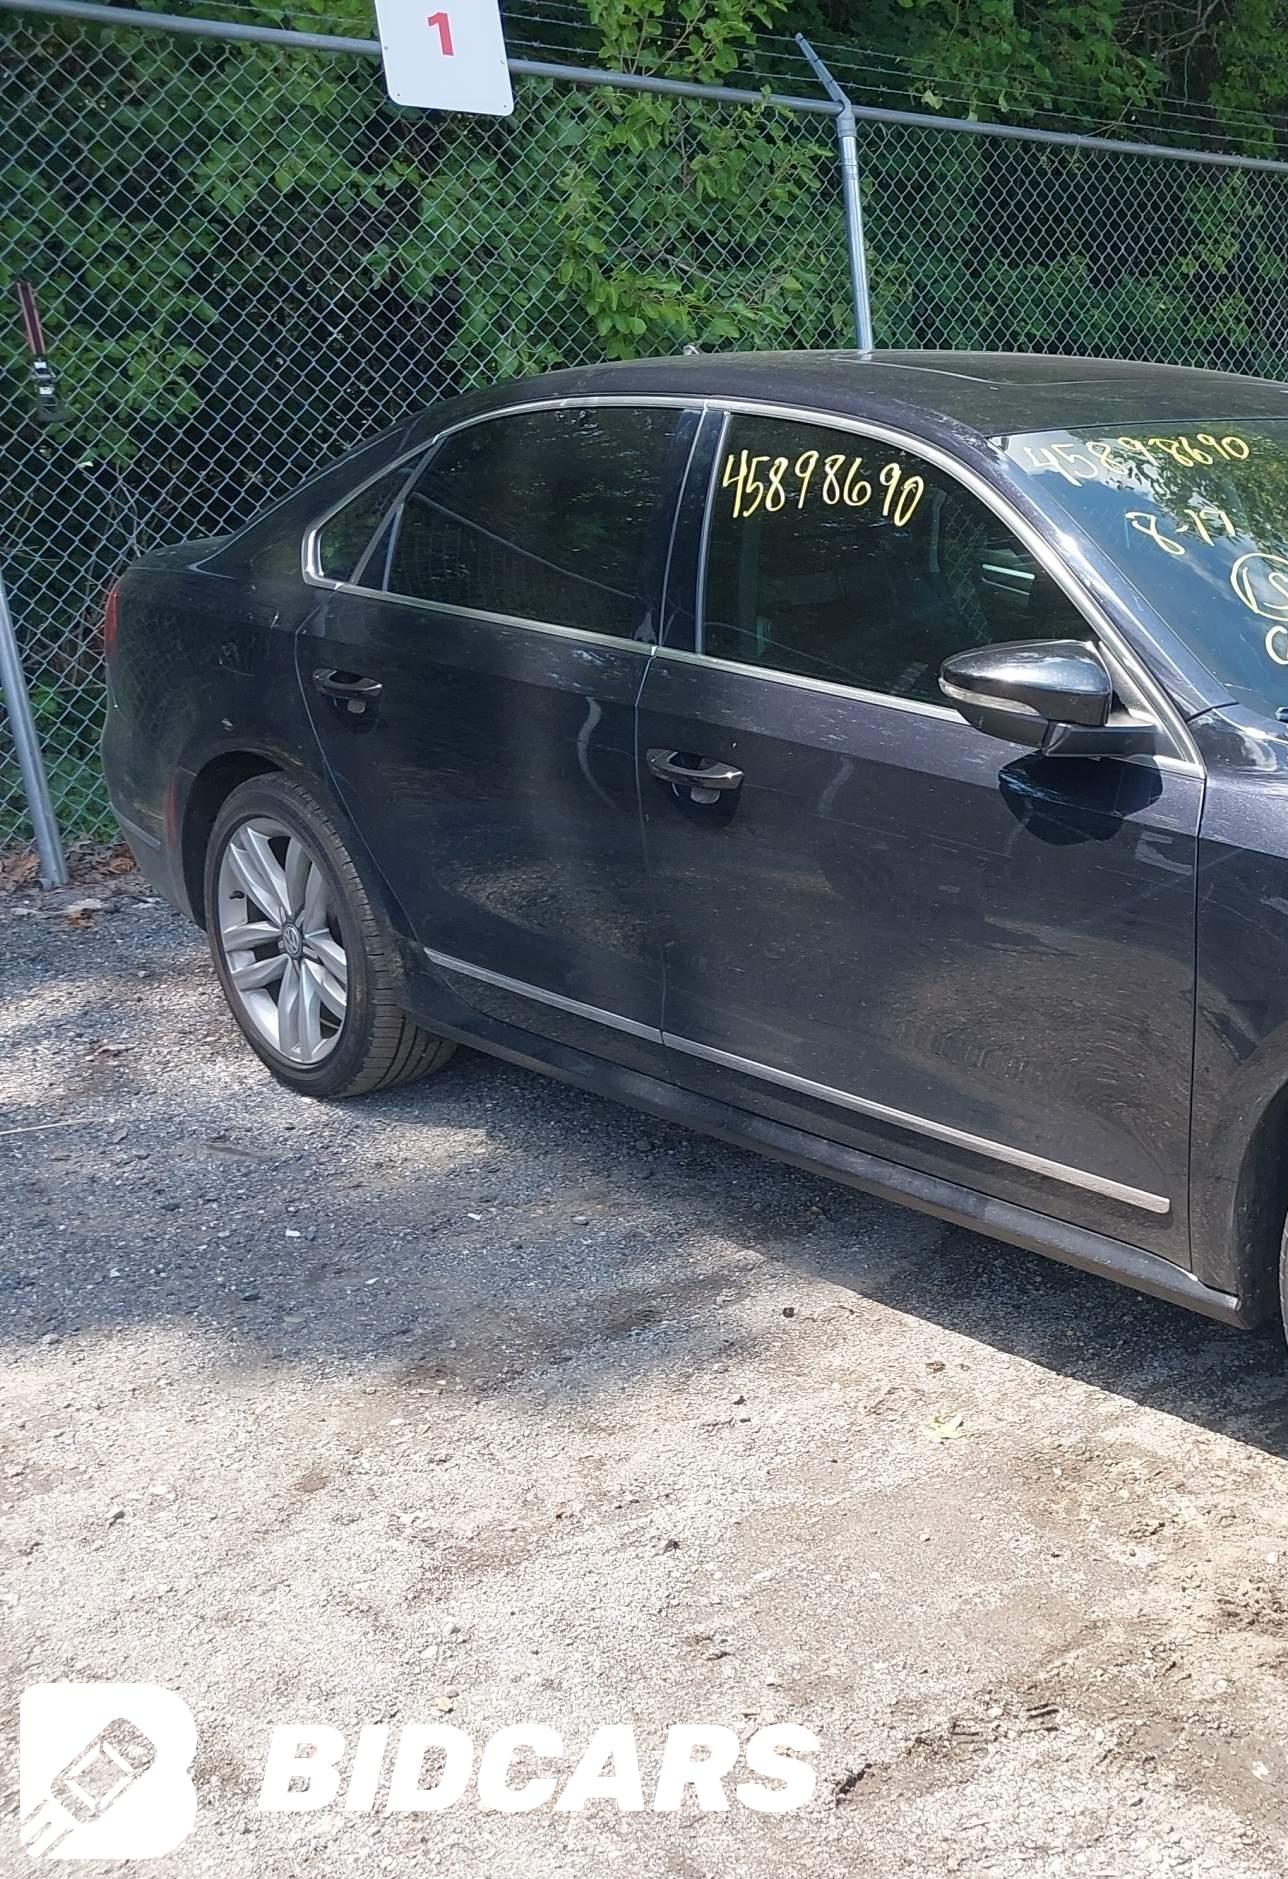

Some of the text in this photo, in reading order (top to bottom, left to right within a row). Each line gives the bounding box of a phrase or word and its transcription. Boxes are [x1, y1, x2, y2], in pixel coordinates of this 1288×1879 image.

[427, 11, 454, 56] 1
[1024, 433, 1250, 487] 45898690
[722, 449, 924, 527] 45898690
